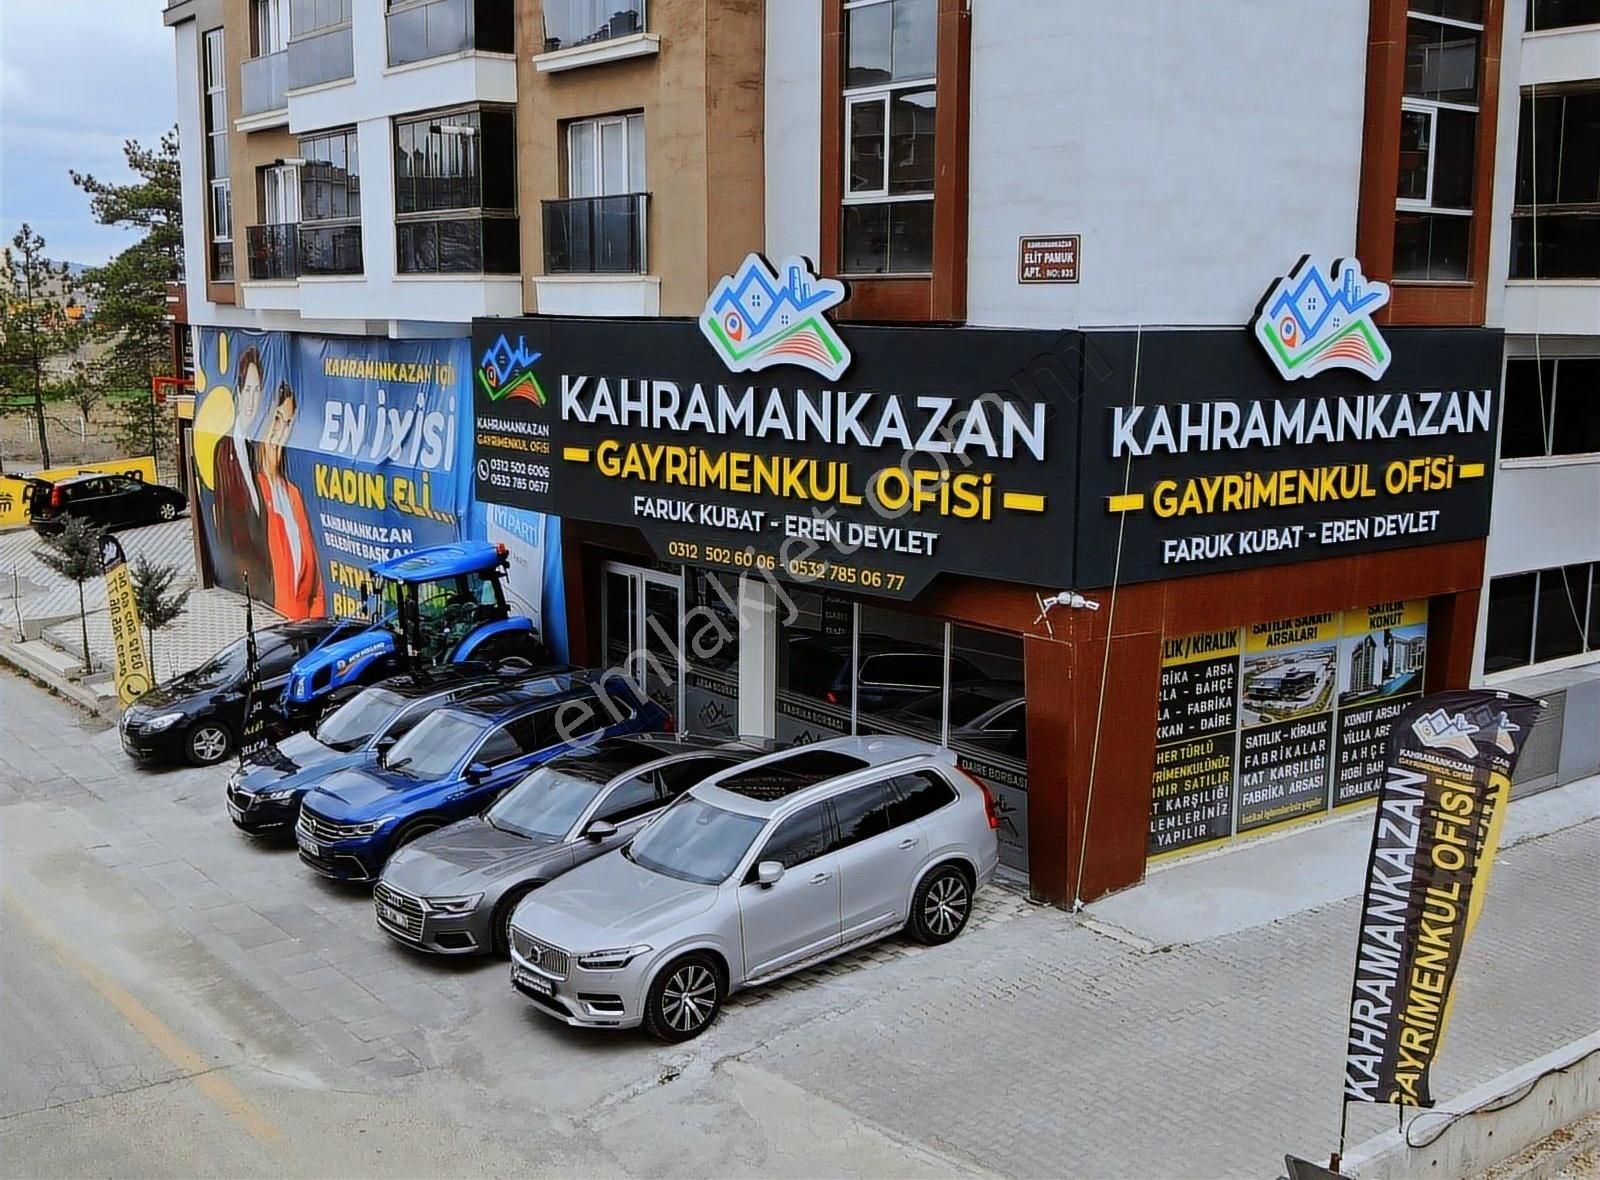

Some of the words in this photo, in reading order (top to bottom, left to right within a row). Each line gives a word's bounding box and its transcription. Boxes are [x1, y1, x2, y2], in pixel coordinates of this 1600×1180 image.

[476, 416, 550, 437] KAHRAMANKAZAN
[561, 374, 1046, 461] KAHRAMANKAZAN
[1111, 389, 1492, 458] KAHRAMANKAZAN
[319, 400, 366, 456] EN
[370, 389, 455, 472] İYİSİ
[490, 458, 509, 472] 0312
[510, 461, 526, 475] 502
[527, 464, 550, 478] 6006
[315, 463, 386, 511] KADIN
[490, 473, 511, 487] 0532
[512, 477, 527, 490] 785
[528, 480, 549, 494] 0677
[320, 512, 413, 544] KAHRAMANKAZAN
[633, 495, 695, 523] FARUK
[699, 503, 766, 533] KUBAT
[785, 515, 842, 544] EREN
[848, 522, 938, 557] DEVLET
[1162, 532, 1233, 564] FARUK
[1238, 525, 1304, 556] KUBAT
[1320, 518, 1369, 544] EREN
[1374, 510, 1440, 538] DEVLET
[668, 541, 699, 560] 0312
[705, 546, 731, 564] 502
[734, 550, 754, 568] 60
[756, 554, 776, 571] 06
[789, 559, 827, 579] 0532
[829, 566, 857, 584] 785
[860, 570, 882, 587] 06
[886, 573, 906, 591] 77
[1368, 612, 1404, 630] KONUT
[1266, 626, 1318, 648] ARSALARI
[1205, 662, 1234, 679] ARSA
[1195, 677, 1233, 695] BAHÇE
[1187, 695, 1232, 716] FABRİKA
[1200, 713, 1232, 731] DAİRE
[1344, 710, 1374, 727] KONUT
[1245, 729, 1282, 749] SATILIK
[1290, 720, 1327, 740] KİRALIK
[1156, 750, 1178, 765] HER
[1180, 739, 1214, 760] TÜRLÜ
[1244, 739, 1326, 768] FABRİKALAR
[1342, 743, 1386, 763] BAHÇE
[1399, 748, 1475, 773] KAHRAMANKAZAN
[1184, 770, 1230, 791] SATILIR
[1243, 770, 1265, 788] KAT
[1270, 755, 1325, 780] KARŞILIĞI
[1341, 762, 1363, 781] HOBİ
[1166, 785, 1229, 812] KARŞILIĞI
[1242, 784, 1285, 807] FABRİKA
[1288, 774, 1324, 795] ARSASI
[1340, 780, 1374, 799] KİRALIK
[1157, 824, 1207, 847] YAPILIR
[1431, 778, 1476, 872] OFİSİ
[1344, 767, 1428, 1102] KAHRAMANKAZAN
